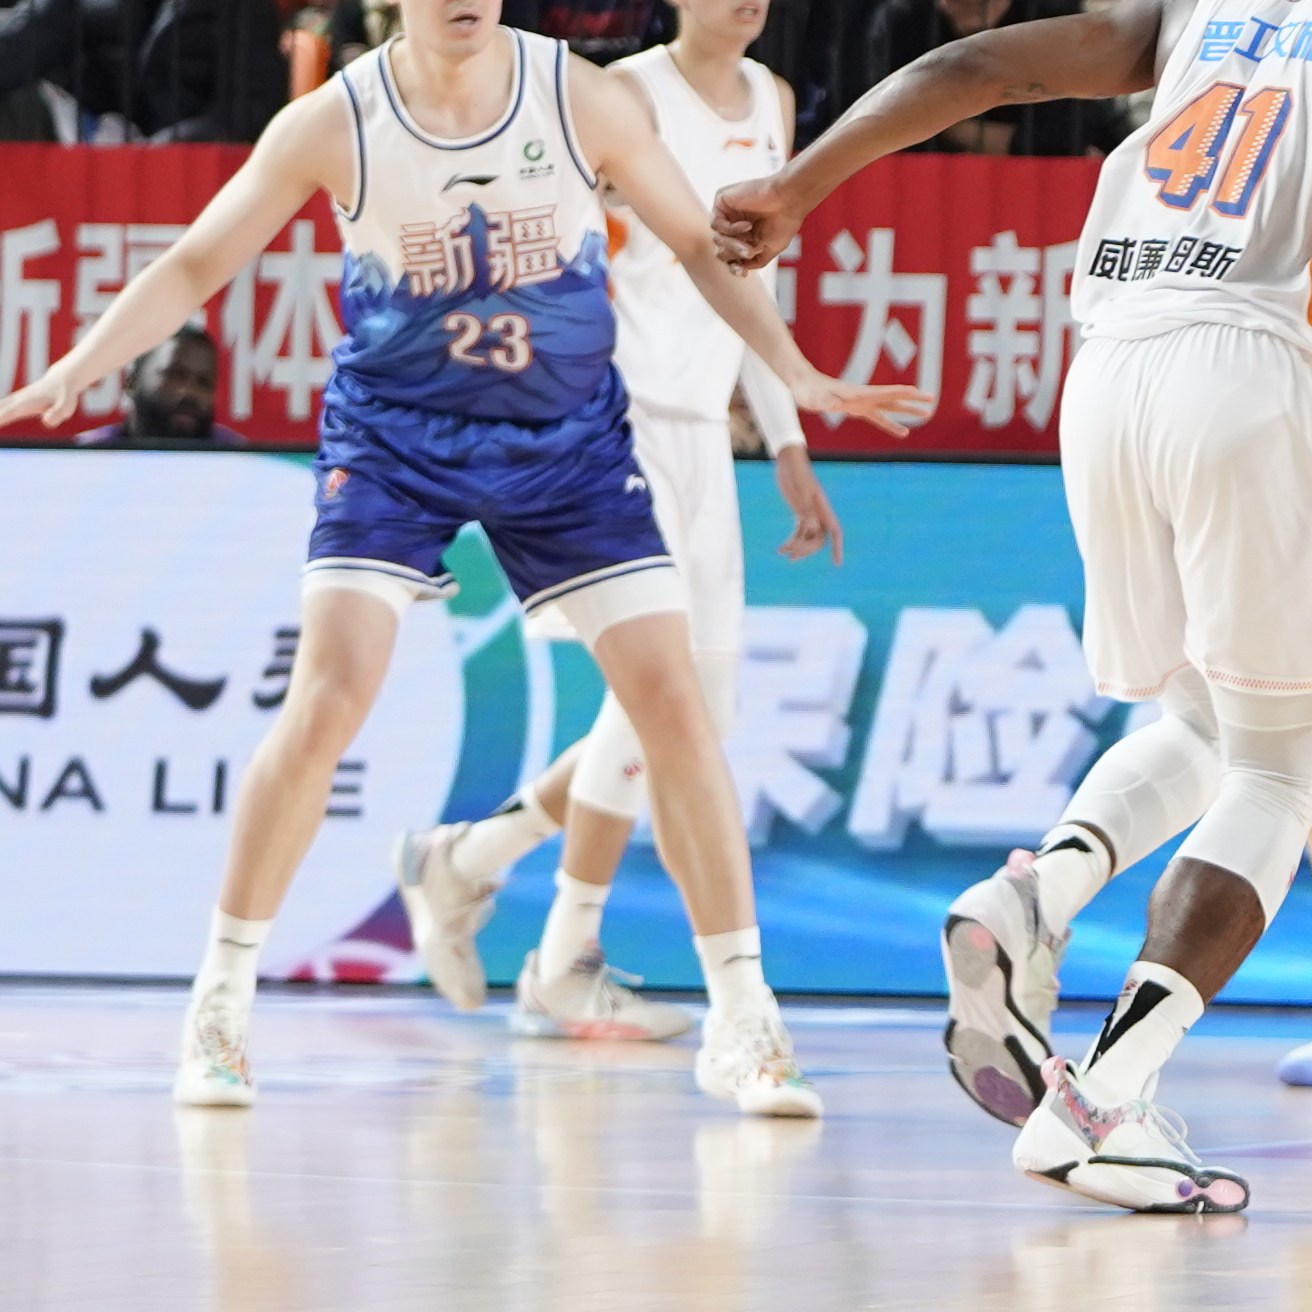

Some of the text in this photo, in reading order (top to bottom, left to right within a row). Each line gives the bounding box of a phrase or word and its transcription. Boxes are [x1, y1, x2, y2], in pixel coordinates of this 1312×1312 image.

[1144, 80, 1294, 219] 41
[399, 204, 564, 297] 新疆
[444, 311, 534, 373] 23
[151, 756, 367, 818] LIE
